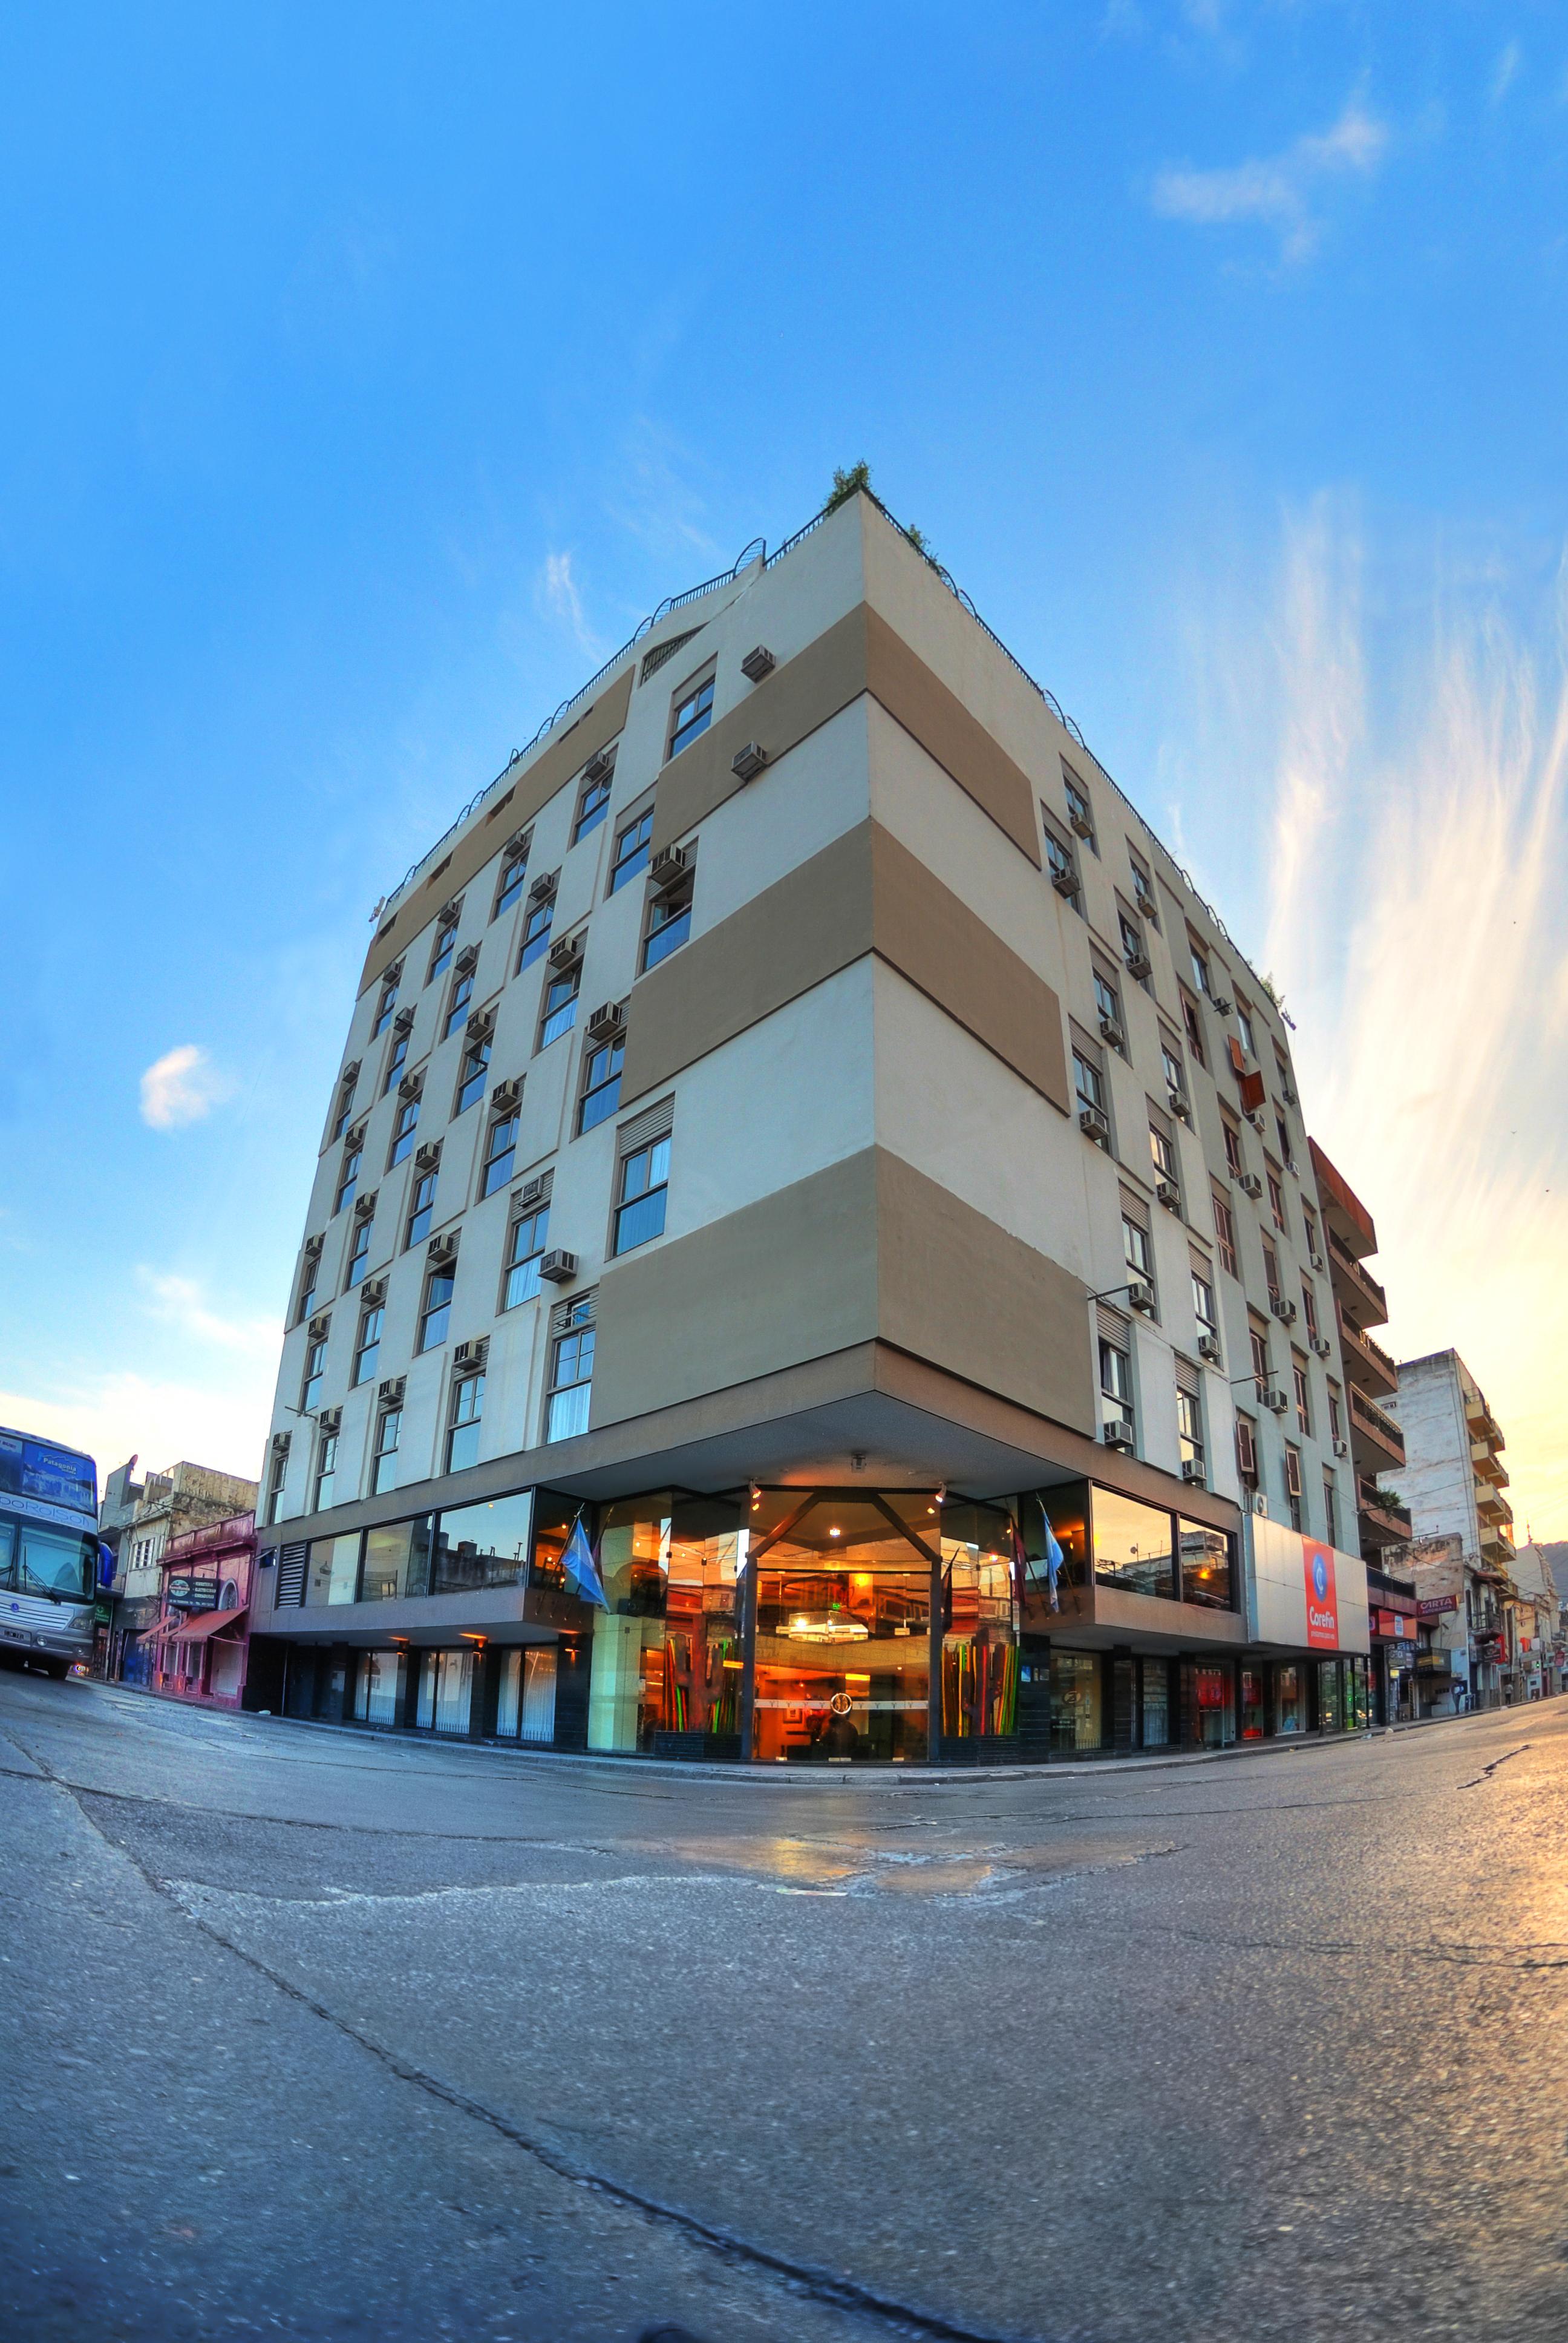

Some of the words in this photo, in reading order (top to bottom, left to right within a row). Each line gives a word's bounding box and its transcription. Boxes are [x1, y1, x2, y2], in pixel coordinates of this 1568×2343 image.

[43, 1457, 76, 1471] Patagonia
[1420, 1598, 1452, 1610] CARTA
[1310, 1606, 1334, 1628] Corefin
